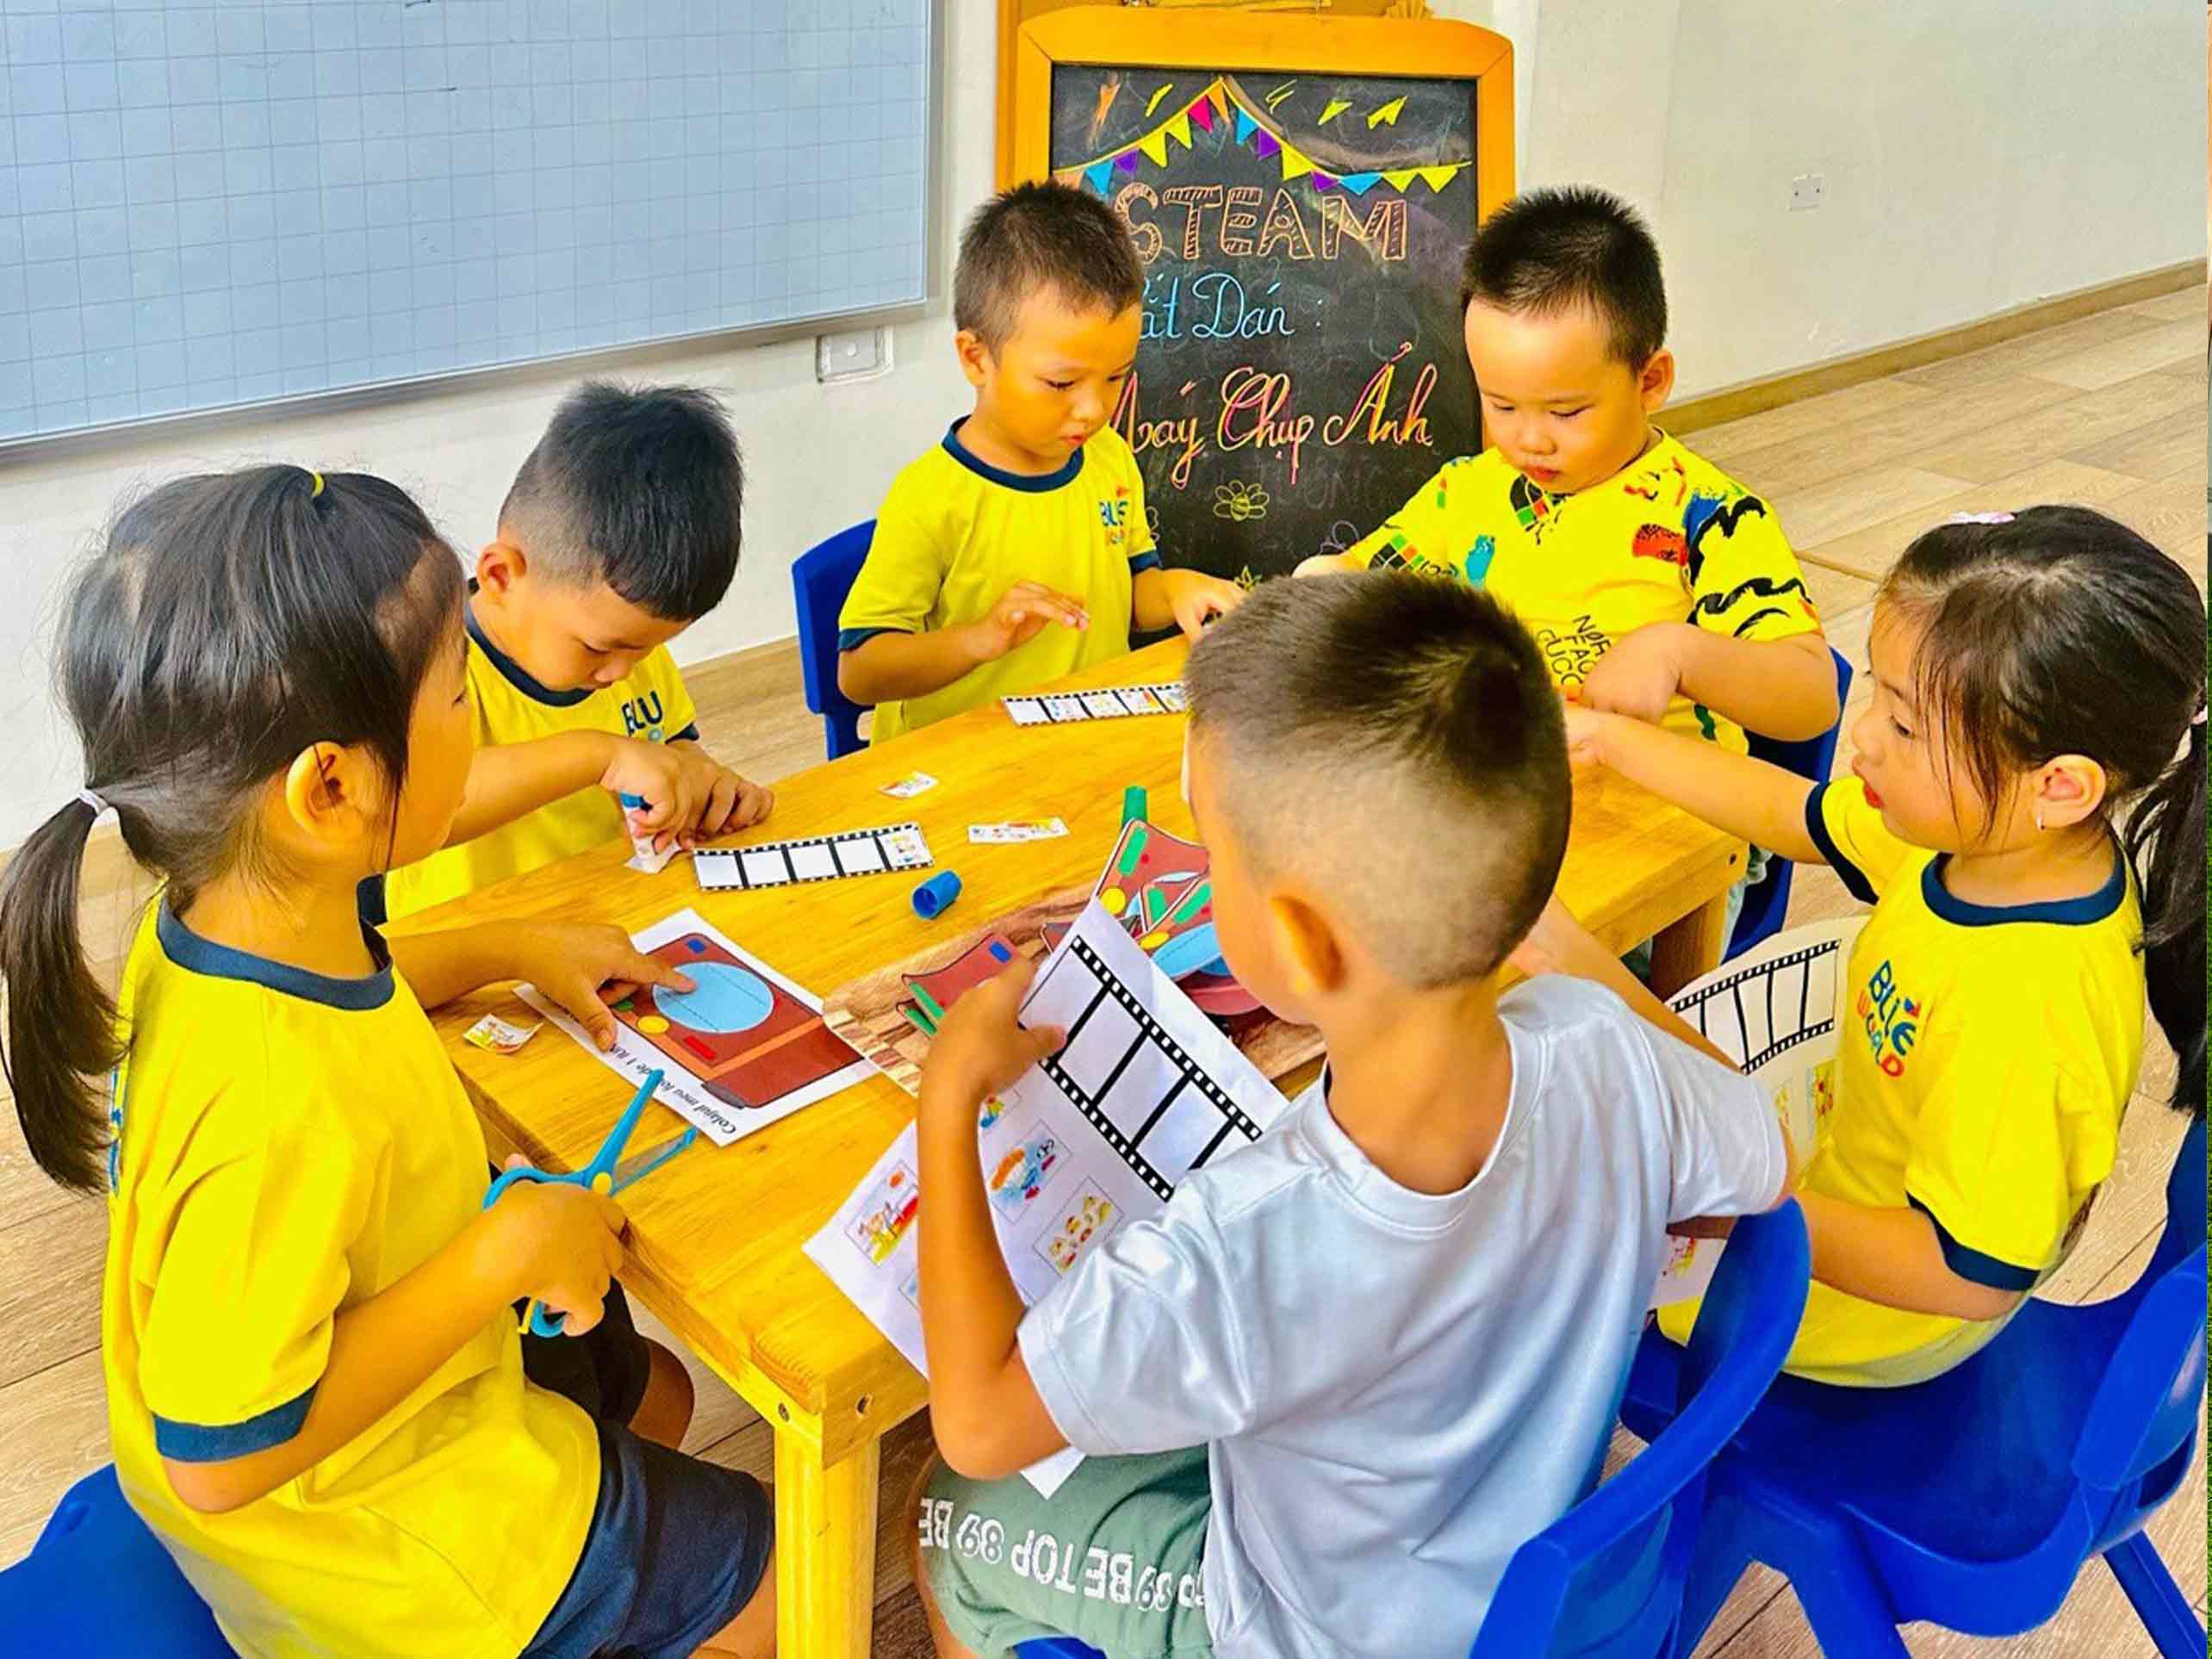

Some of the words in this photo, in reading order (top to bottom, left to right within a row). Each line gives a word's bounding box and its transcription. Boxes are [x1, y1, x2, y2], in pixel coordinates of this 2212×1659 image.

[1114, 181, 1407, 264] STEAM
[1140, 273, 1184, 339] ắt
[1192, 272, 1296, 339] Dán
[1217, 365, 1312, 485] Chụp
[1323, 341, 1438, 448] Ảnh
[917, 1497, 954, 1550] BE
[956, 1513, 1006, 1565] 89
[1010, 1528, 1077, 1594] TOP
[1083, 1547, 1134, 1605] BE
